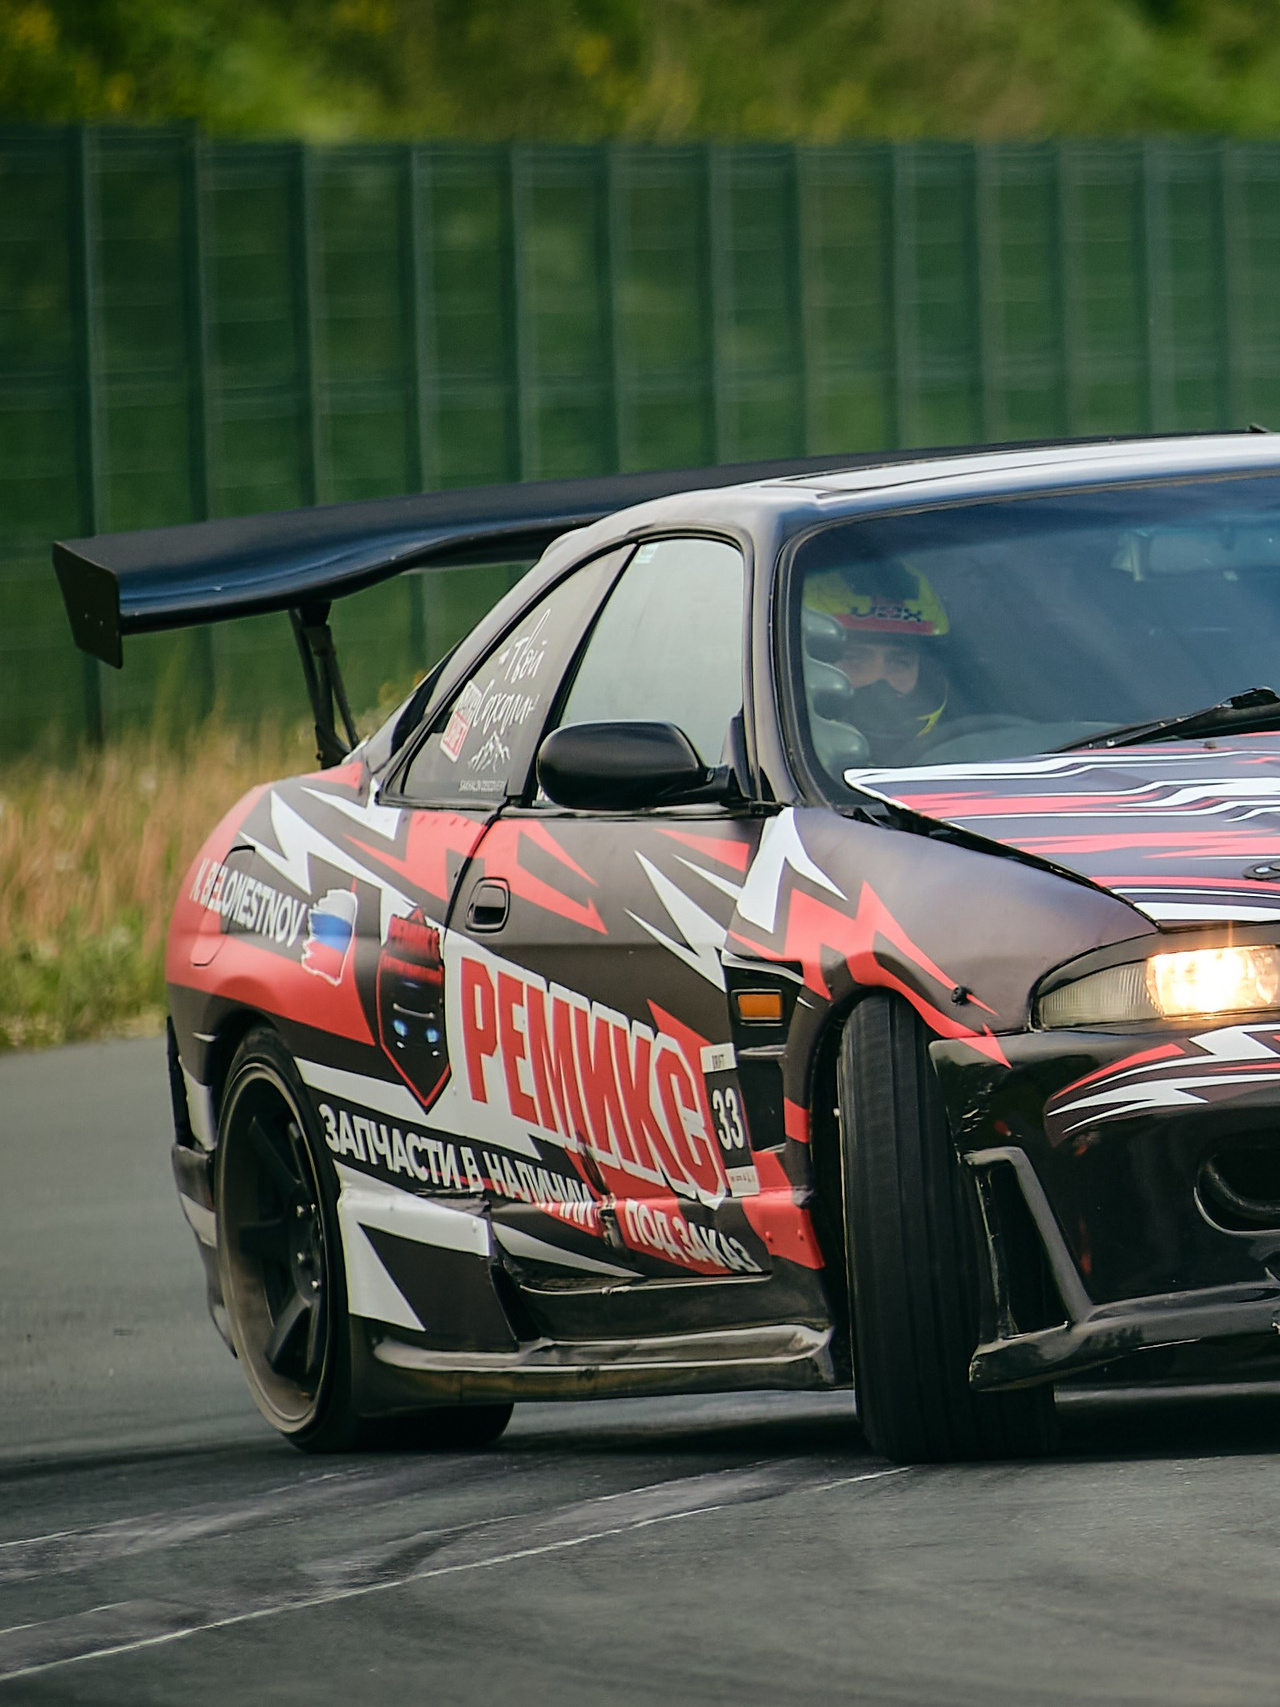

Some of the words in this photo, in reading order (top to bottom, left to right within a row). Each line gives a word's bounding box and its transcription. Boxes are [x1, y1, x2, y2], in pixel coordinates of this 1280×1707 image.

[460, 956, 723, 1200] РЕМИКС
[712, 1087, 744, 1151] 33
[318, 1103, 463, 1190] ЗАПЧАСТИ
[481, 1149, 595, 1229] НАЛИЧИИ
[624, 1197, 683, 1262] ПОД
[672, 1216, 763, 1273] ЗАКАЗ
